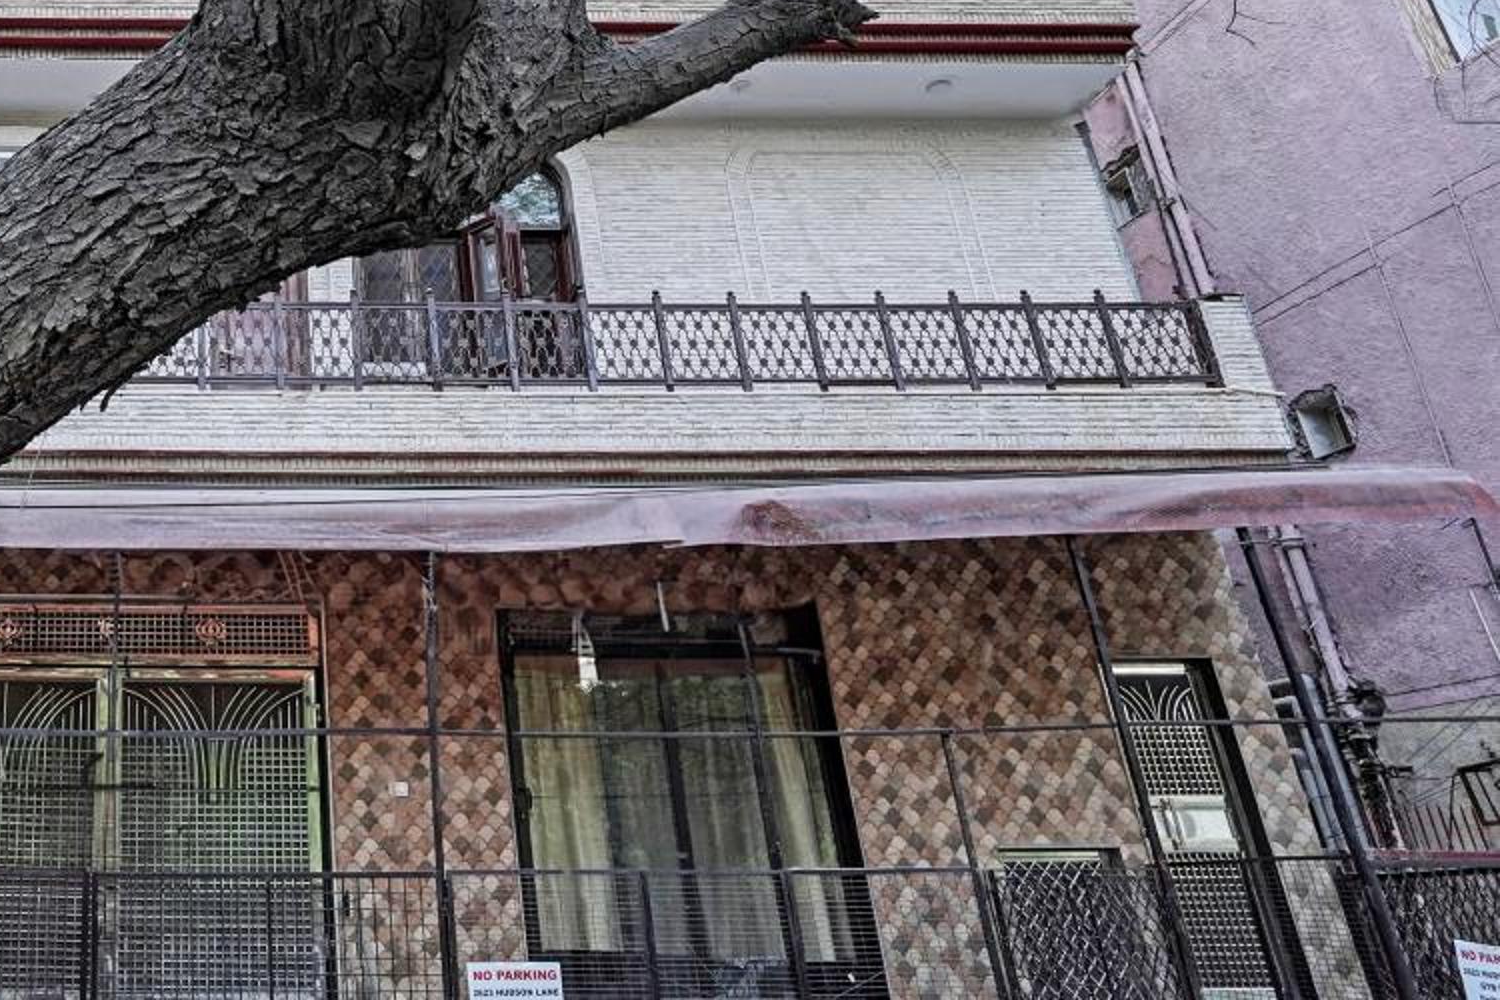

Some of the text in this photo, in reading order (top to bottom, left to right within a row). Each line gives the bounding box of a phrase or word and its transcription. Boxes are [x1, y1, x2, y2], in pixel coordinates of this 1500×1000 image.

[1460, 950, 1477, 961] NO
[473, 969, 558, 981] NO PARKING
[495, 987, 534, 997] HUDSON
[536, 988, 560, 997] LANE
